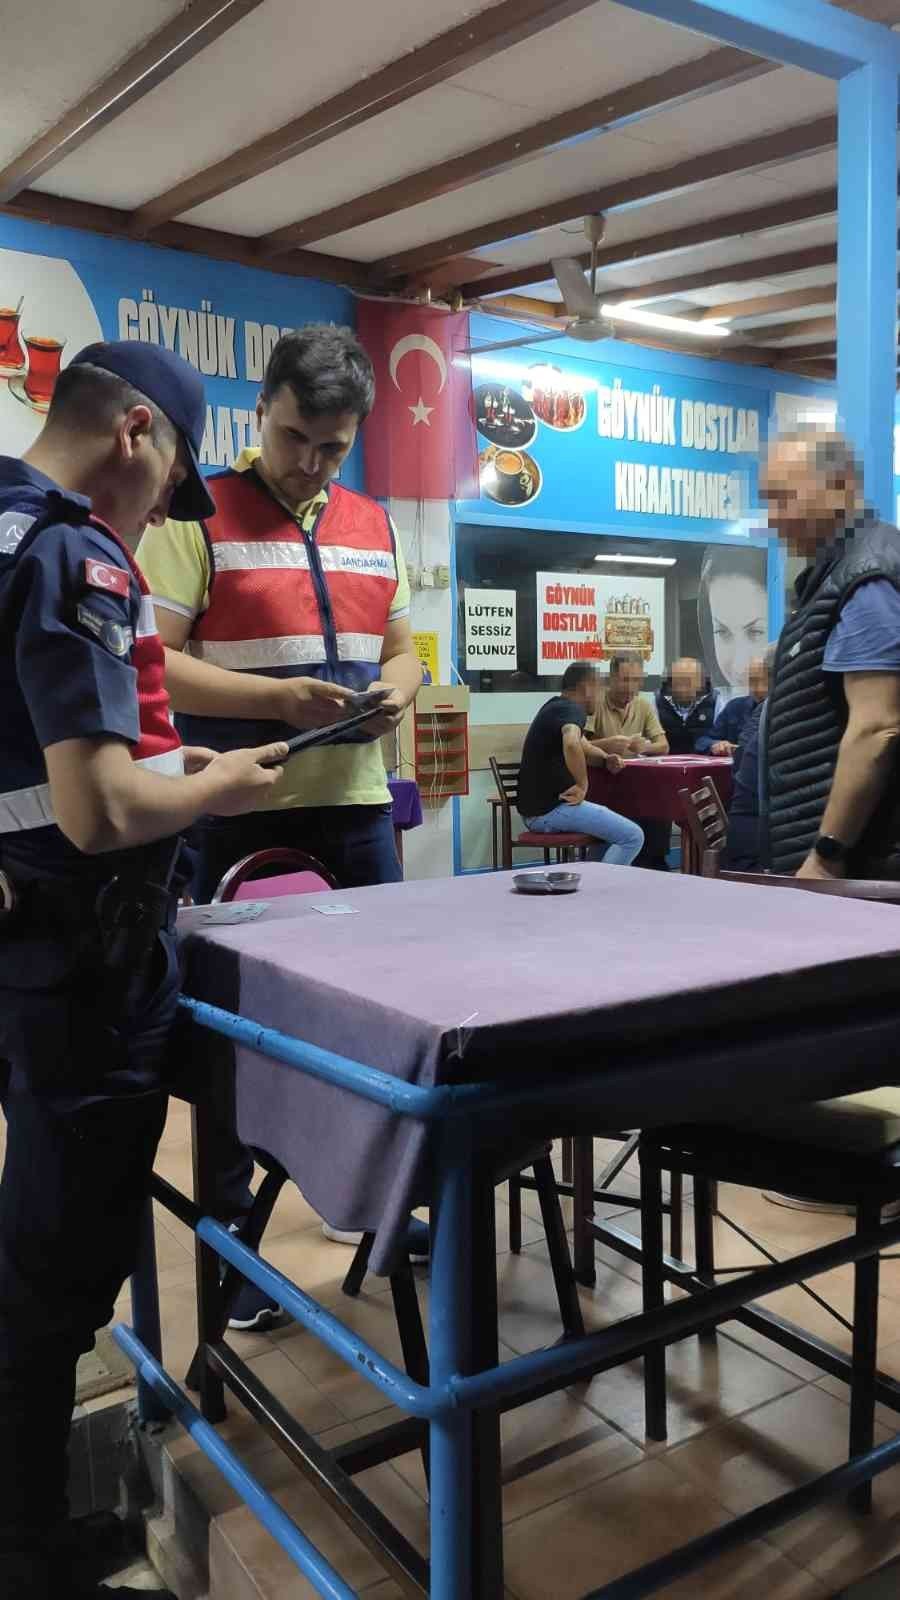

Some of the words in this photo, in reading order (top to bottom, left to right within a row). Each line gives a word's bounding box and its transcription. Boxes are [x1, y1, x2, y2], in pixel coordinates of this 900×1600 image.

[597, 378, 676, 446] GÖYNÜK
[681, 399, 759, 454] DOSTLAR
[545, 583, 595, 606] GÖYNÜK
[468, 604, 513, 617] LÜTFEN
[543, 612, 597, 632] DOSTLAR
[471, 624, 511, 637] SESSİZ
[467, 645, 515, 656] OLUNUZ
